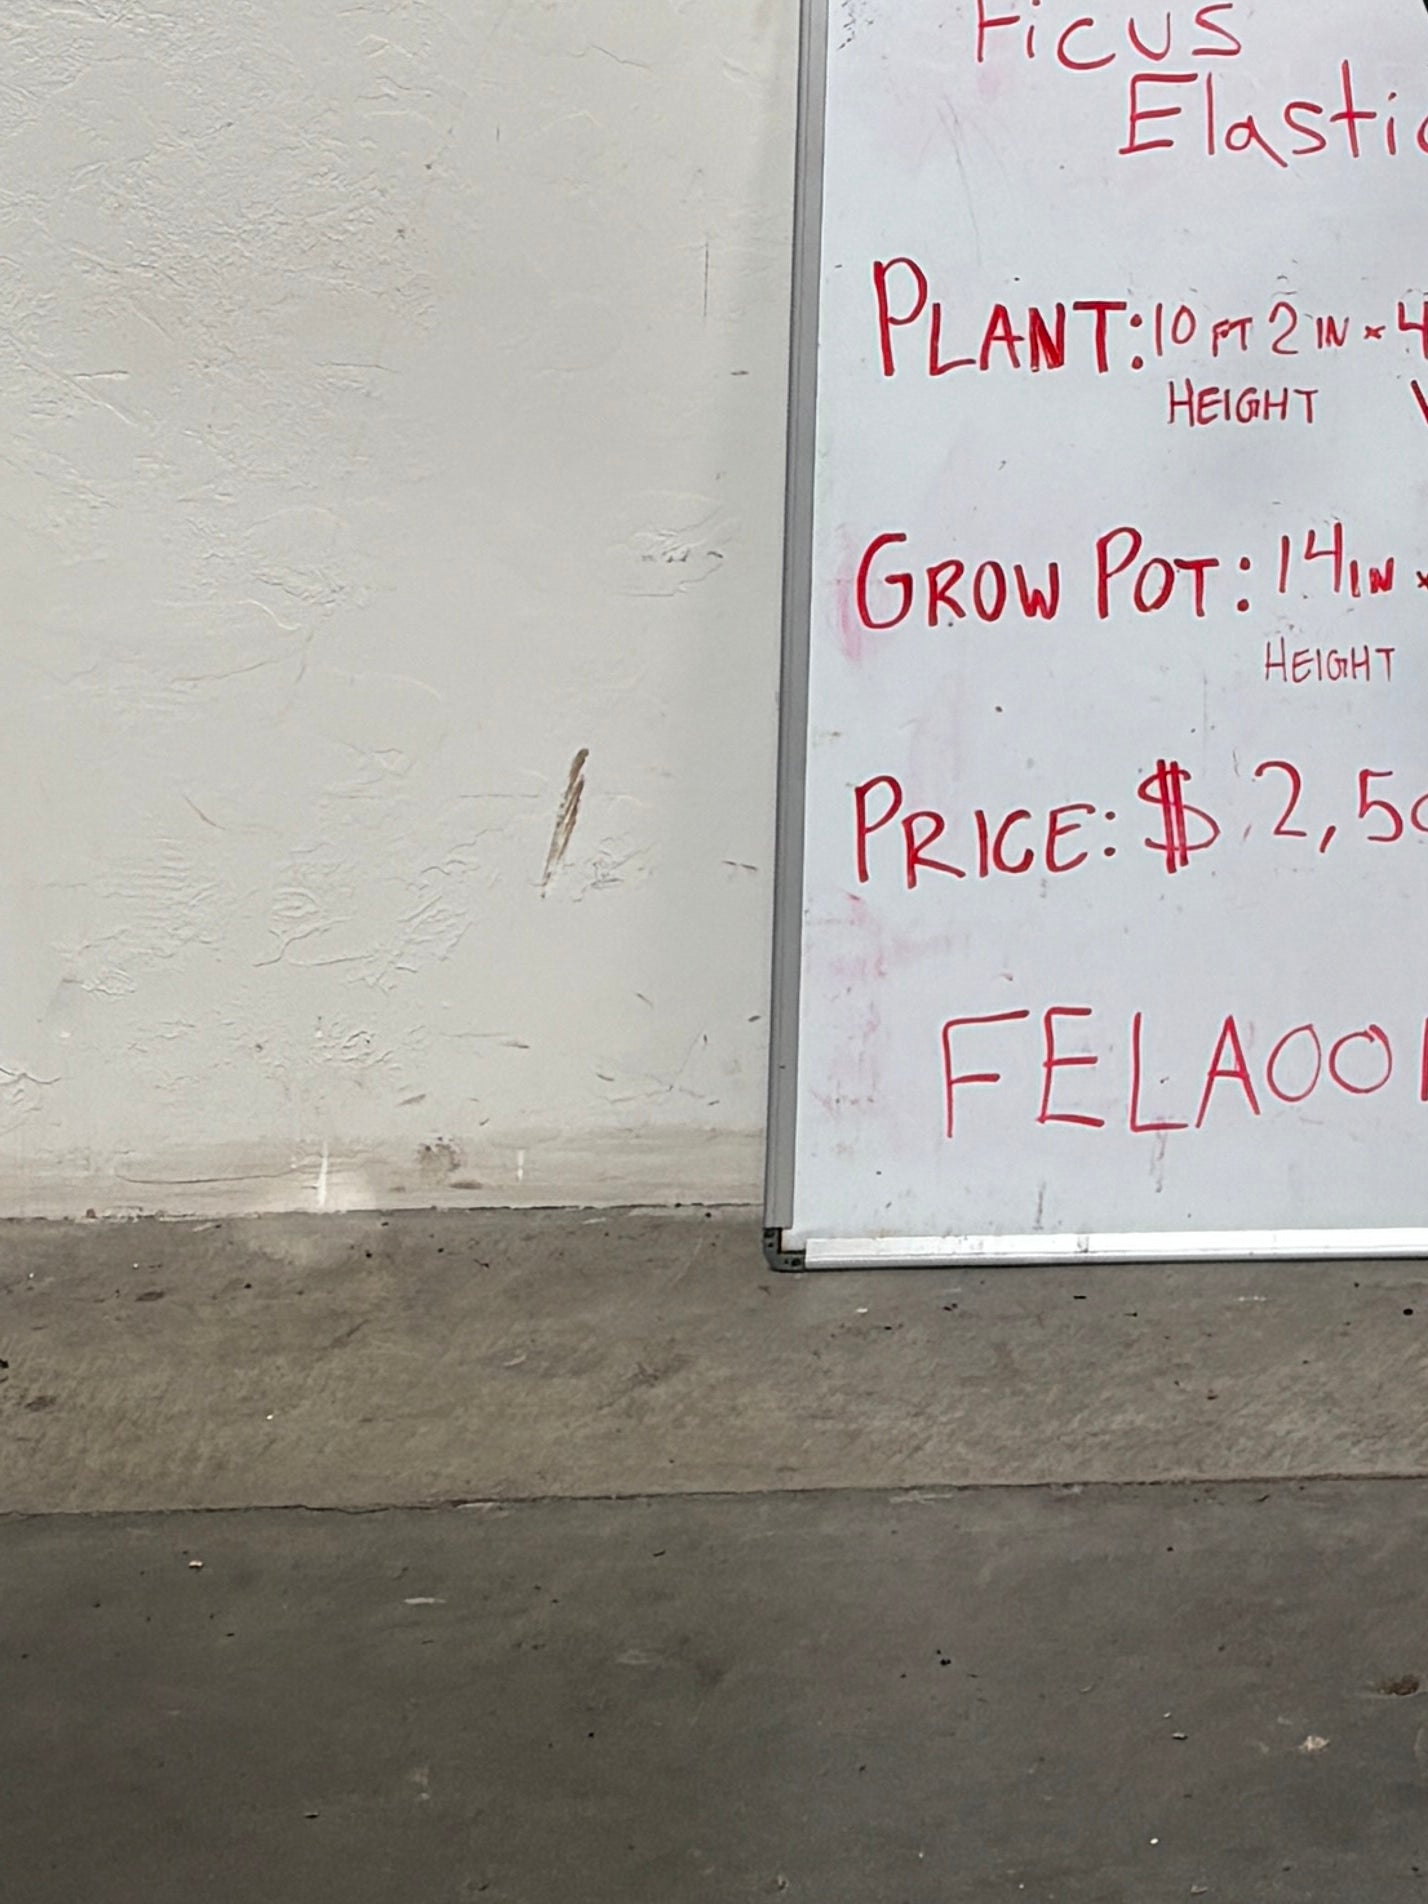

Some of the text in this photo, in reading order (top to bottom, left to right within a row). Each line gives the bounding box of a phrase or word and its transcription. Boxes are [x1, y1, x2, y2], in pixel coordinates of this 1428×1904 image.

[872, 257, 1143, 377] PLANT:
[1154, 304, 1196, 354] 10
[1211, 317, 1251, 355] FT
[1267, 301, 1297, 355] 2
[1314, 315, 1350, 348] IN
[1167, 378, 1319, 428] HEIGHT
[856, 532, 1060, 630] GROW
[1095, 527, 1250, 620] POT:
[1264, 635, 1396, 684] HEIGHT
[854, 775, 1113, 889] PRICE:
[1136, 759, 1220, 875] $
